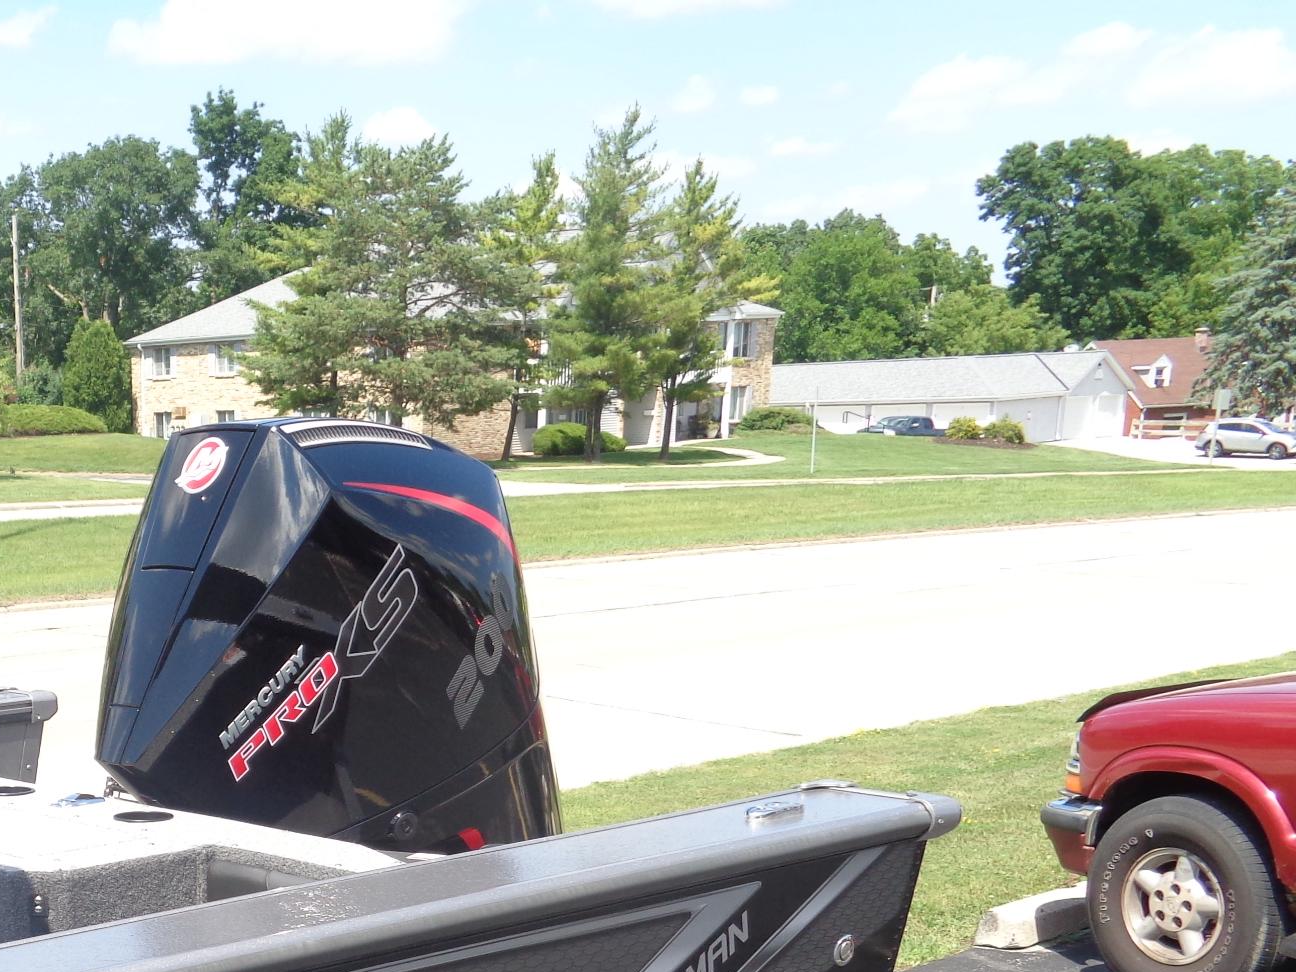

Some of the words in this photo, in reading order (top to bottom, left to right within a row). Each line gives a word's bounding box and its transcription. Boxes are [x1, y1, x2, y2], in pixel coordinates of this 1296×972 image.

[219, 644, 305, 750] MERCURY
[227, 651, 339, 783] PRO
[311, 543, 418, 735] XS
[446, 571, 515, 730] 200
